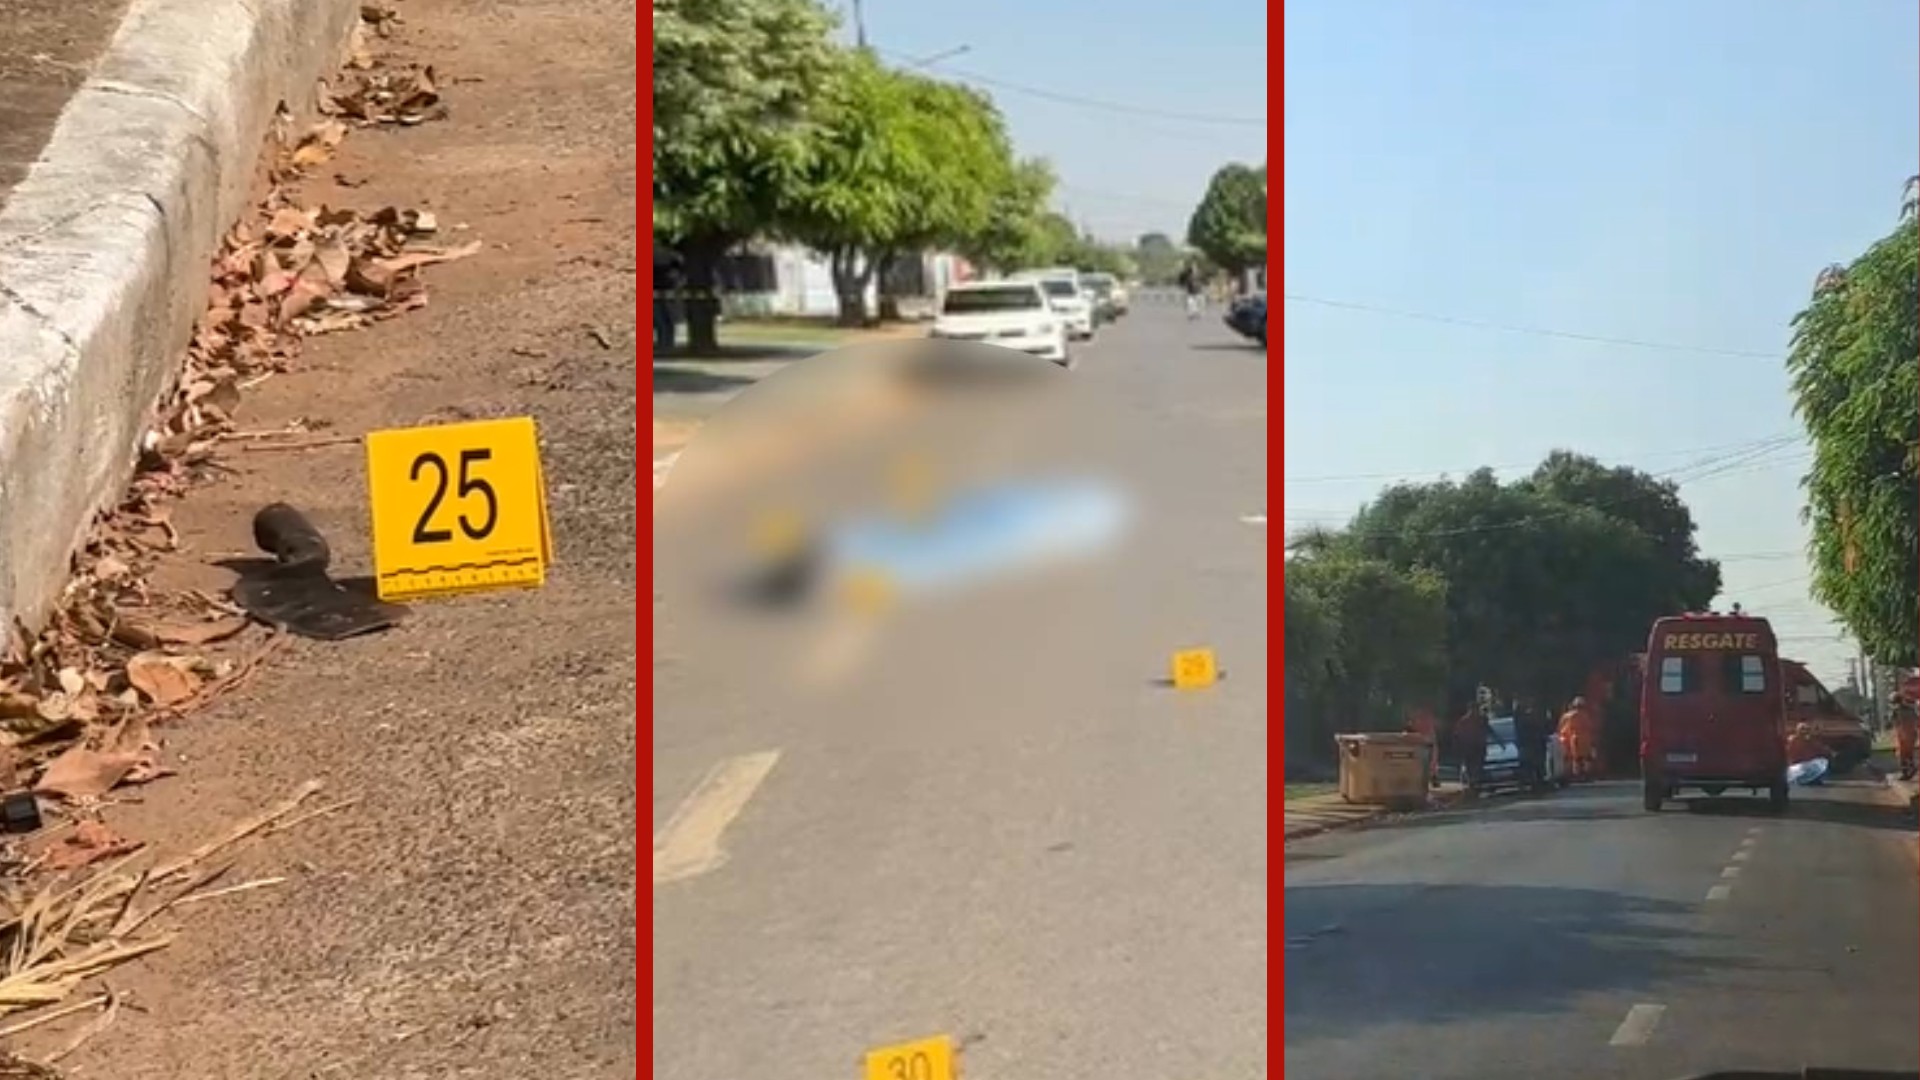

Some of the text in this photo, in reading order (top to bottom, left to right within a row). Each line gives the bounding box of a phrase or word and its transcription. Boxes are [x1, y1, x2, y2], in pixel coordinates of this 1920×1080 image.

[410, 448, 498, 543] 25
[1664, 632, 1758, 650] RESGATE
[887, 1051, 932, 1080] 30
